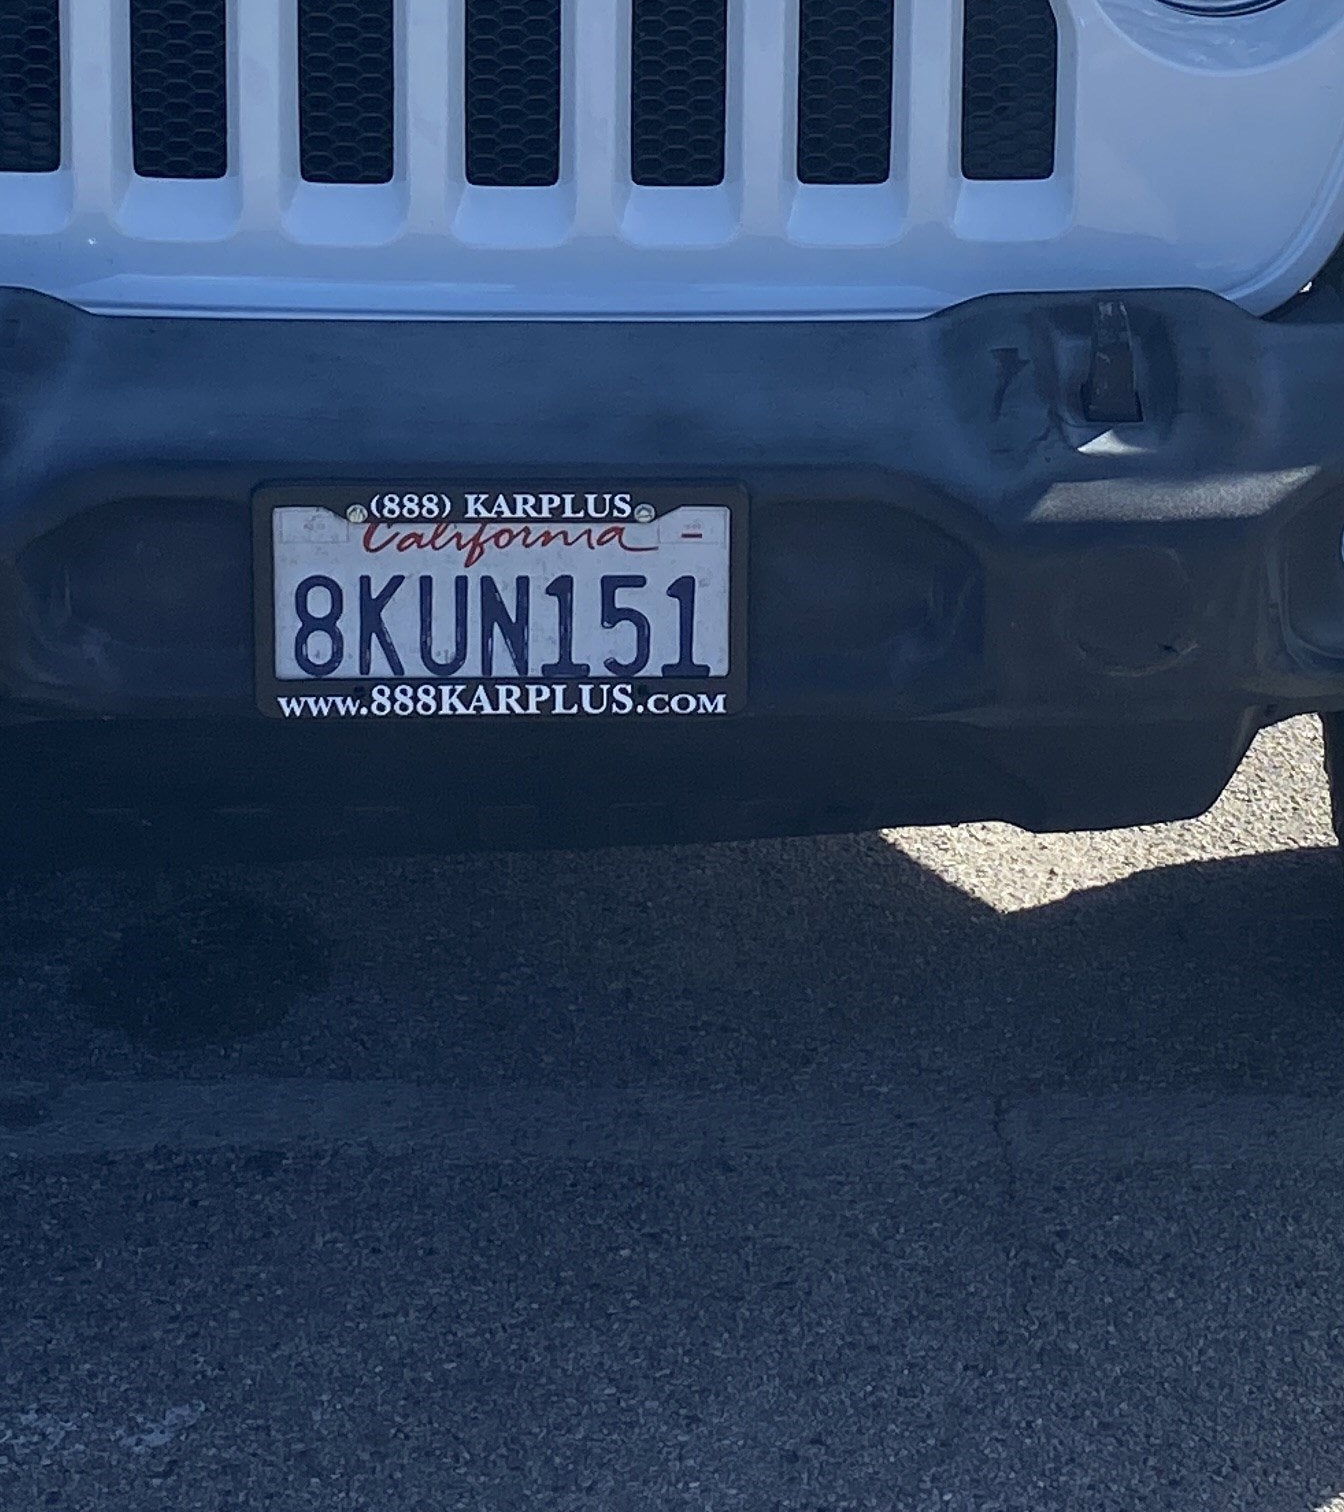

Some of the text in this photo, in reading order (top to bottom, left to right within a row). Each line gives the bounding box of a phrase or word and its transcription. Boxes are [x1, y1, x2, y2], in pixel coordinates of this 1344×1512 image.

[370, 493, 632, 520] (888) KARPLUS
[362, 523, 659, 568] California
[293, 574, 712, 678] 8KUN151
